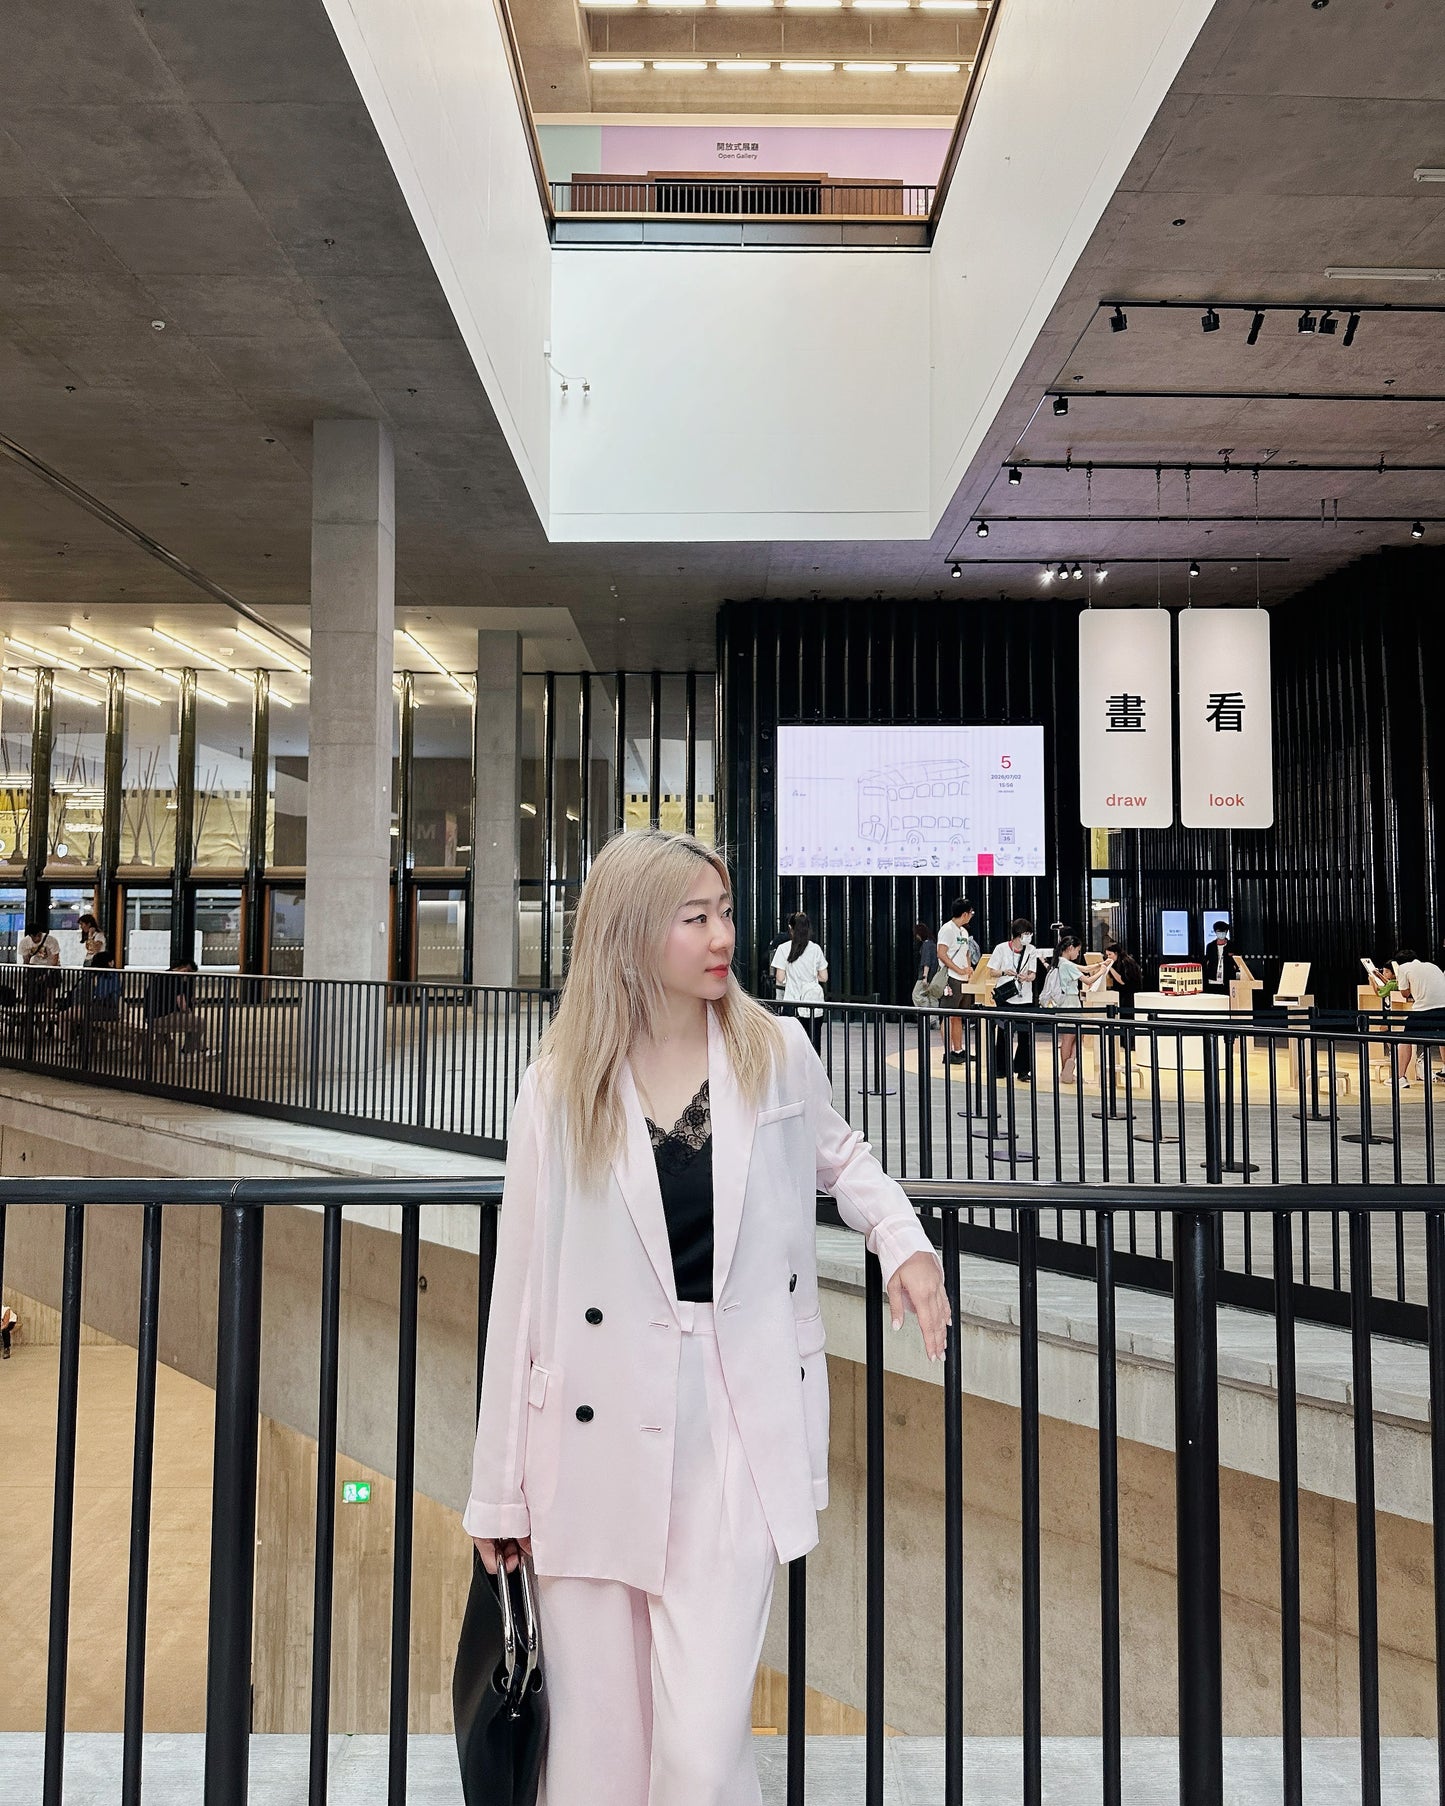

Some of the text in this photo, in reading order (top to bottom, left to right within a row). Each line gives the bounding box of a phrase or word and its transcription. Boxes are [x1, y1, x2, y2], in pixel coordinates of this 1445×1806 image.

[1105, 692, 1147, 733] 畫
[1205, 692, 1246, 733] 看
[1001, 755, 1012, 769] 5
[1106, 793, 1148, 807] draw
[1209, 793, 1245, 807] look
